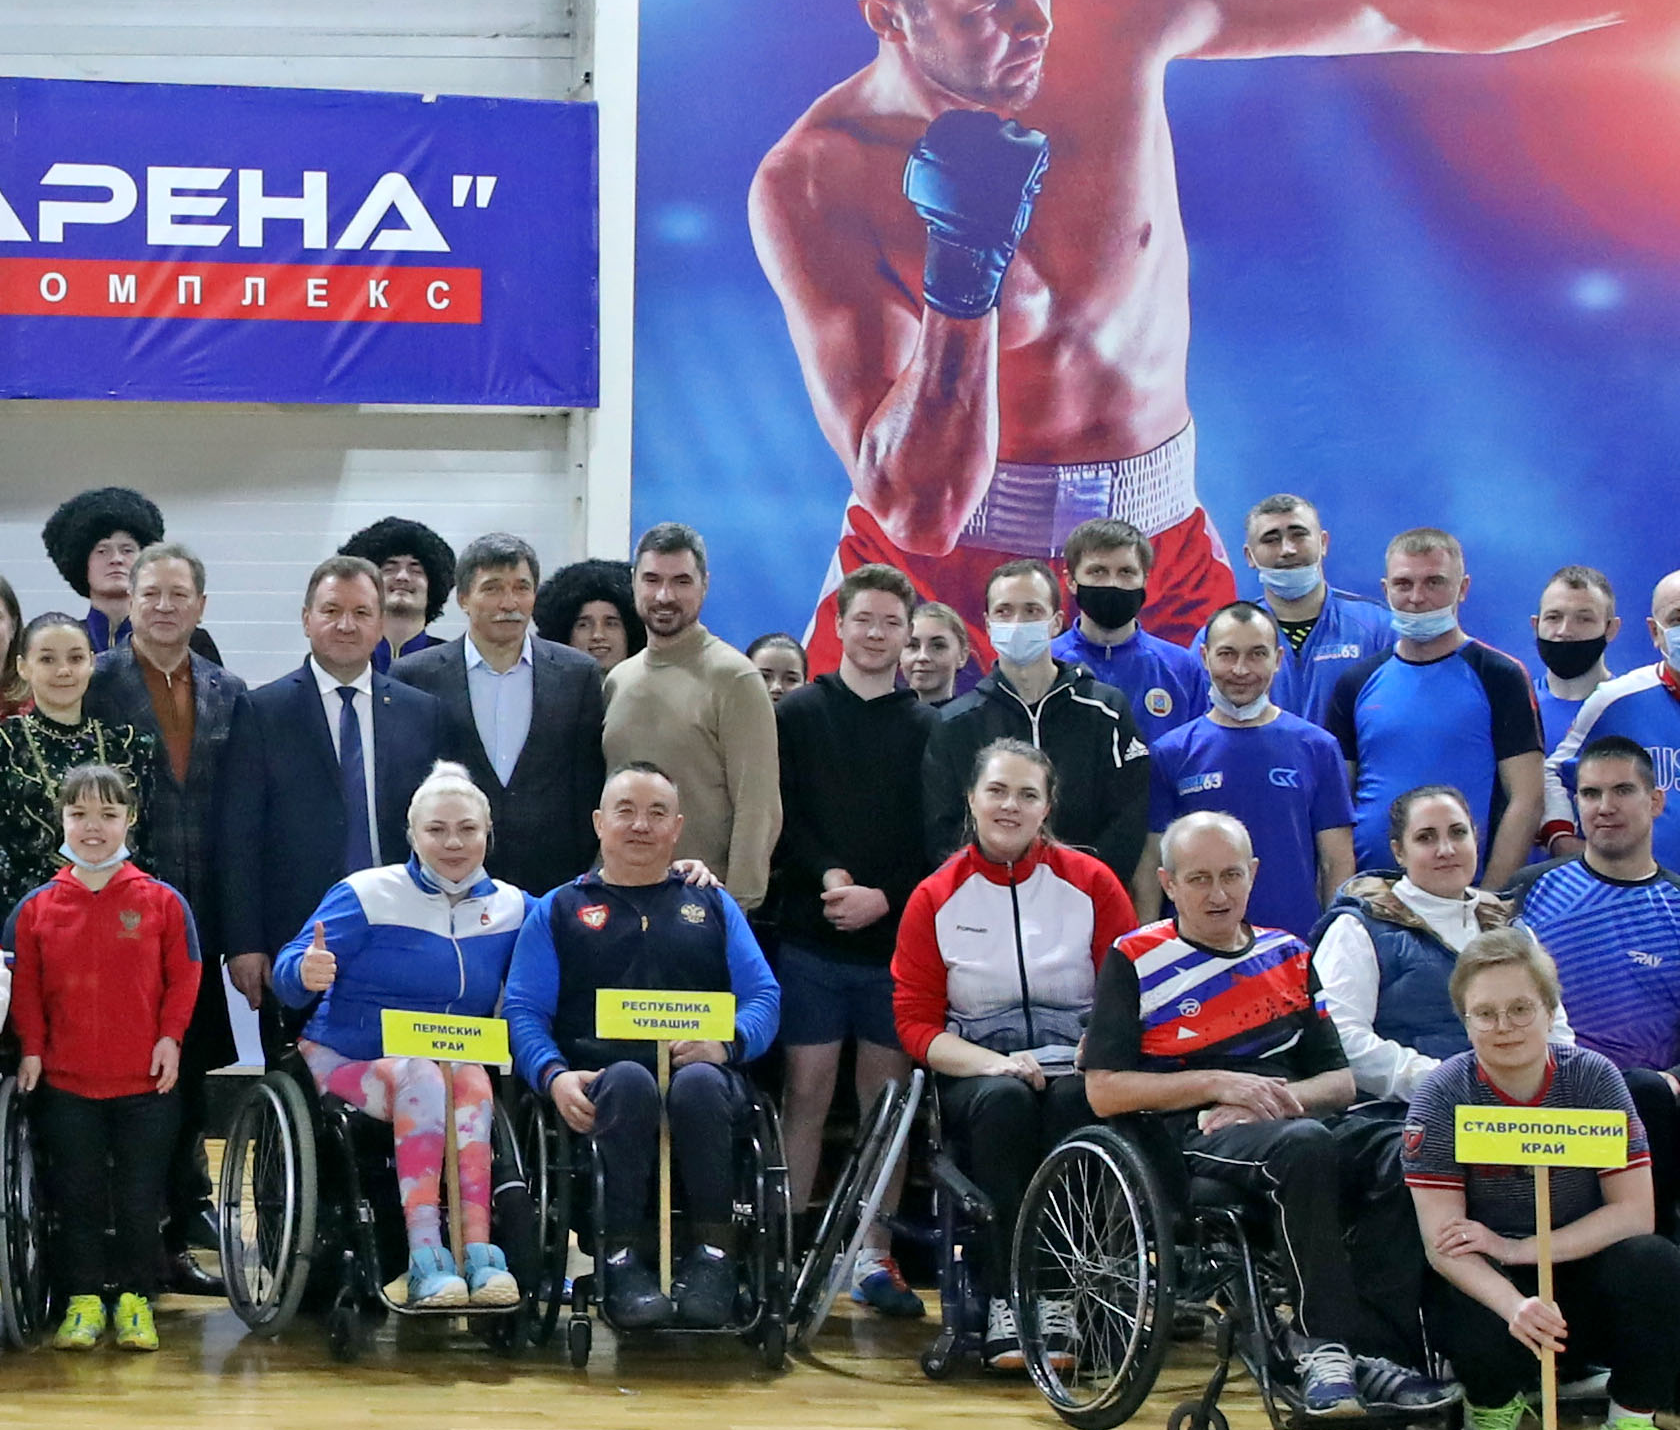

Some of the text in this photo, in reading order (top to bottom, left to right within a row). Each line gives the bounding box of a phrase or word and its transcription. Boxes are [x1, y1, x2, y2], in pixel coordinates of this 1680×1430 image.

[621, 1000, 711, 1013] РЕСПУБЛИКА
[413, 1023, 482, 1036] ПЕРМСКИЙ
[633, 1017, 700, 1030] ЧУВАШИЯ
[432, 1039, 465, 1051] КРАЙ
[1463, 1120, 1624, 1137] СТАВРОПОЛЬСКИЙ
[1521, 1139, 1566, 1154] КРАЙ
